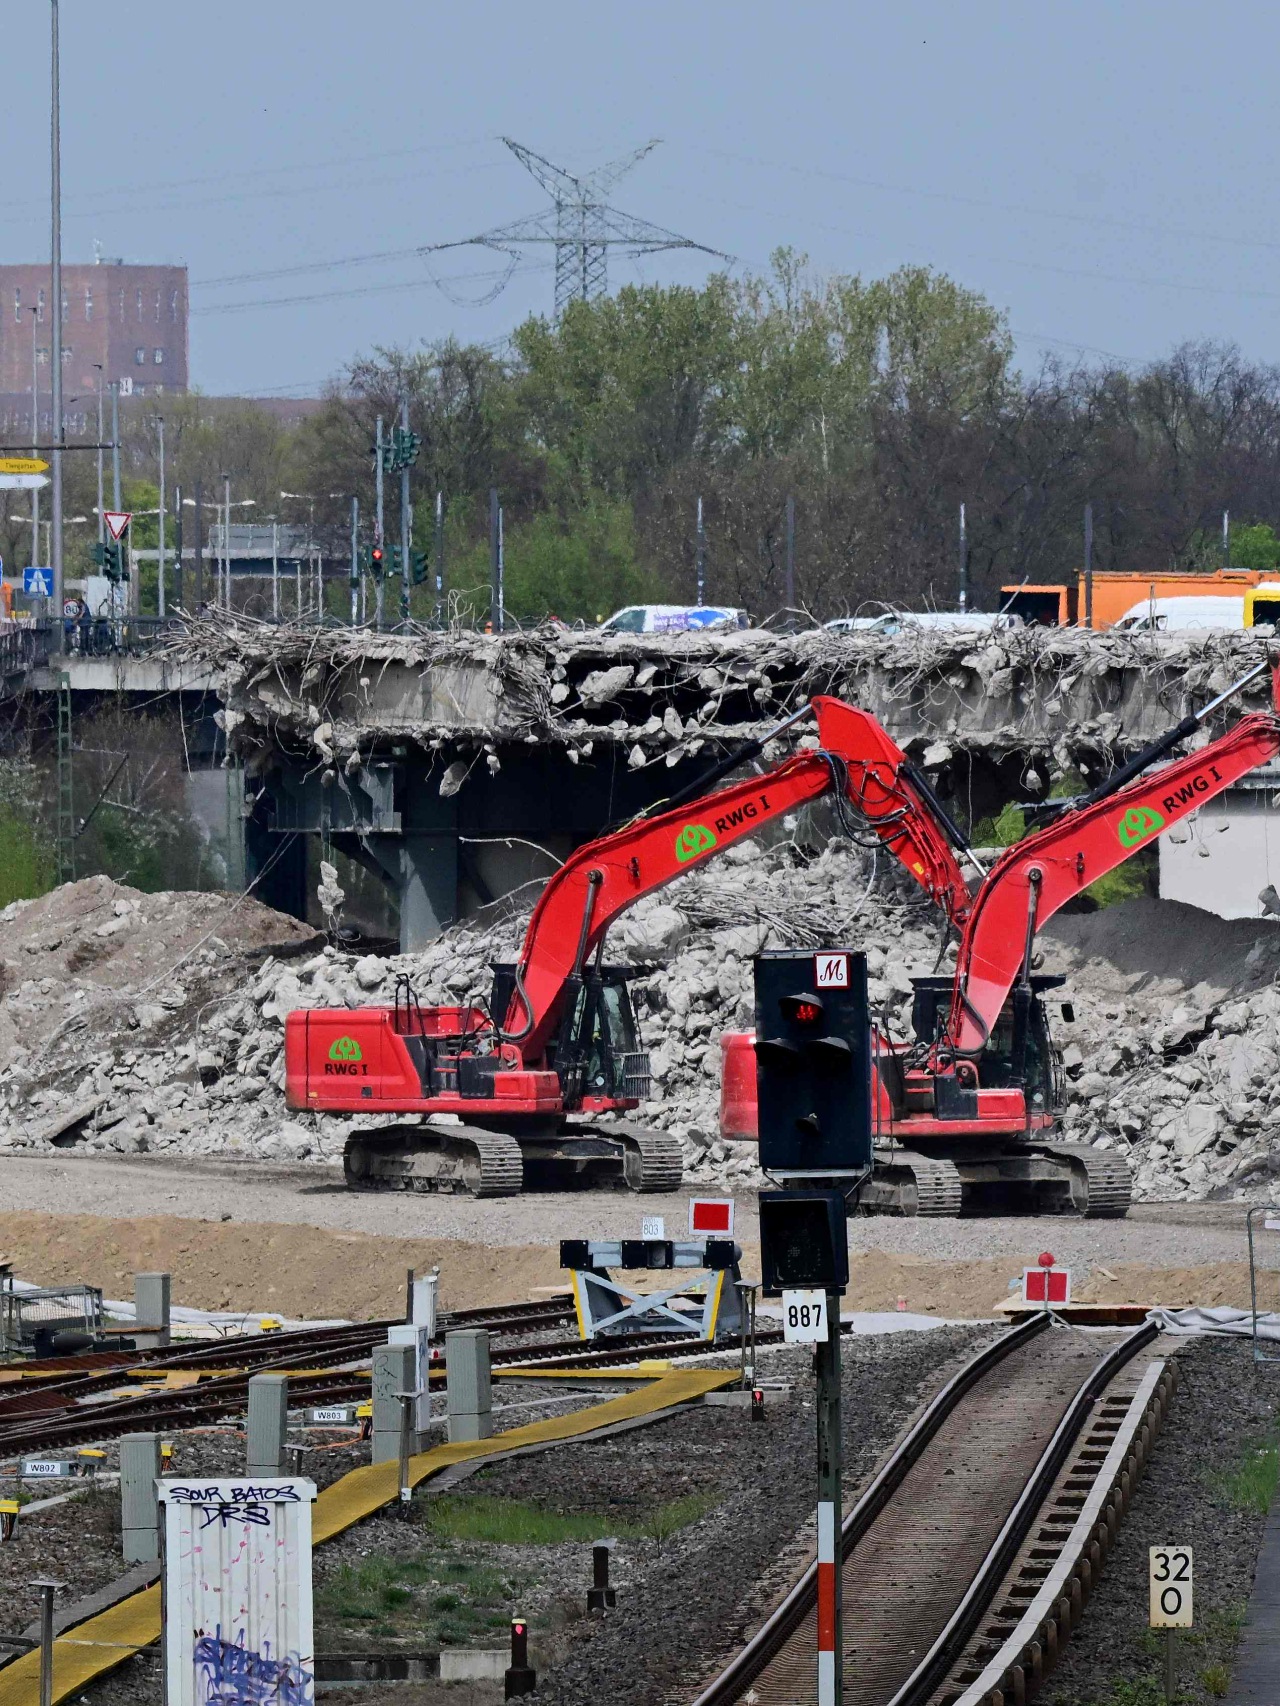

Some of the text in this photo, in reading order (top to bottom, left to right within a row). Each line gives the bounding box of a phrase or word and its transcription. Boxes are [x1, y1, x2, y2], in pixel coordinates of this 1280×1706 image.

[1162, 775, 1210, 814] RWG
[714, 802, 758, 834] RWG
[820, 959, 844, 981] M
[324, 1063, 358, 1076] RWG
[643, 1224, 659, 1236] 803
[788, 1304, 822, 1328] 887
[317, 1411, 341, 1420] W803
[30, 1464, 56, 1473] W802
[1153, 1552, 1190, 1582] 32
[1160, 1586, 1183, 1616] 0
